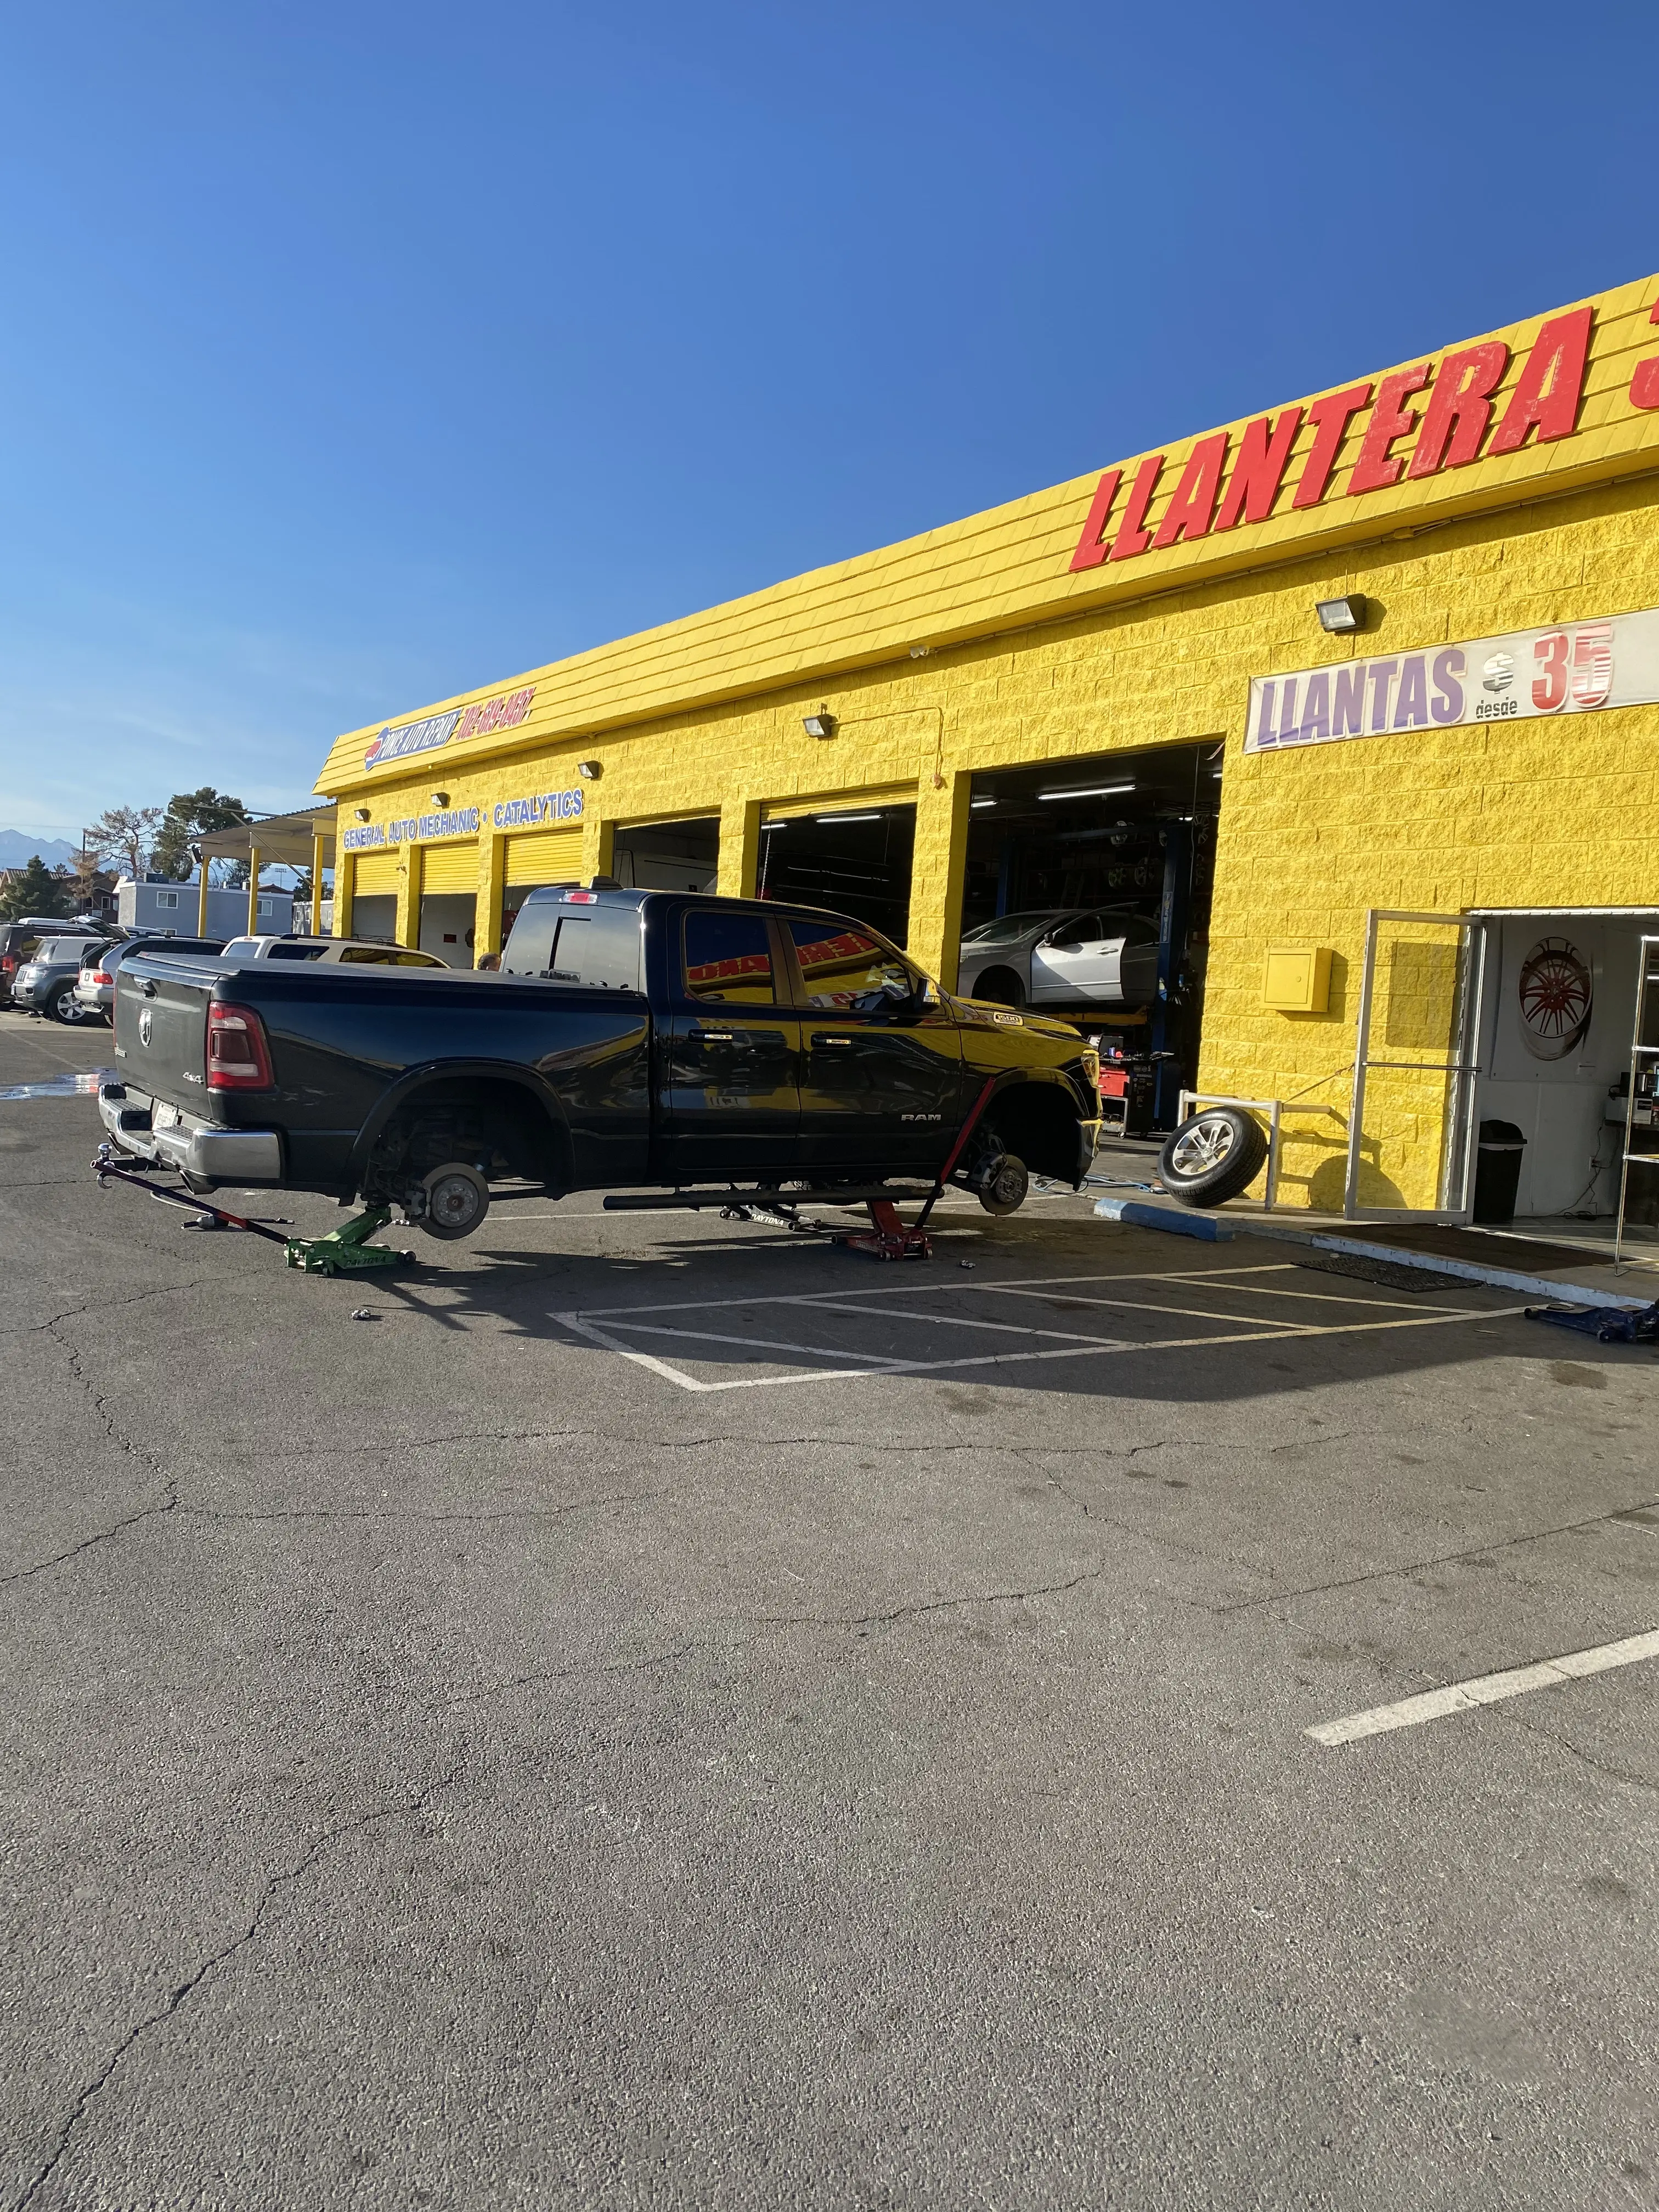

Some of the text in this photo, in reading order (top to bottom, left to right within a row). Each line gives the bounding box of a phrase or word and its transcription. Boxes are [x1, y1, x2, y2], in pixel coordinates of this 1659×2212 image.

[1069, 306, 1593, 572] LLANTERA
[1257, 648, 1466, 747] LLANTAS
[1532, 623, 1612, 712] 35
[1476, 695, 1518, 719] desde
[376, 713, 457, 759] PONCE AUTO REPAIR
[343, 788, 583, 849] GENERAL AUTO MECHANIC CATALYTICS
[752, 1213, 785, 1226] DAYTONA
